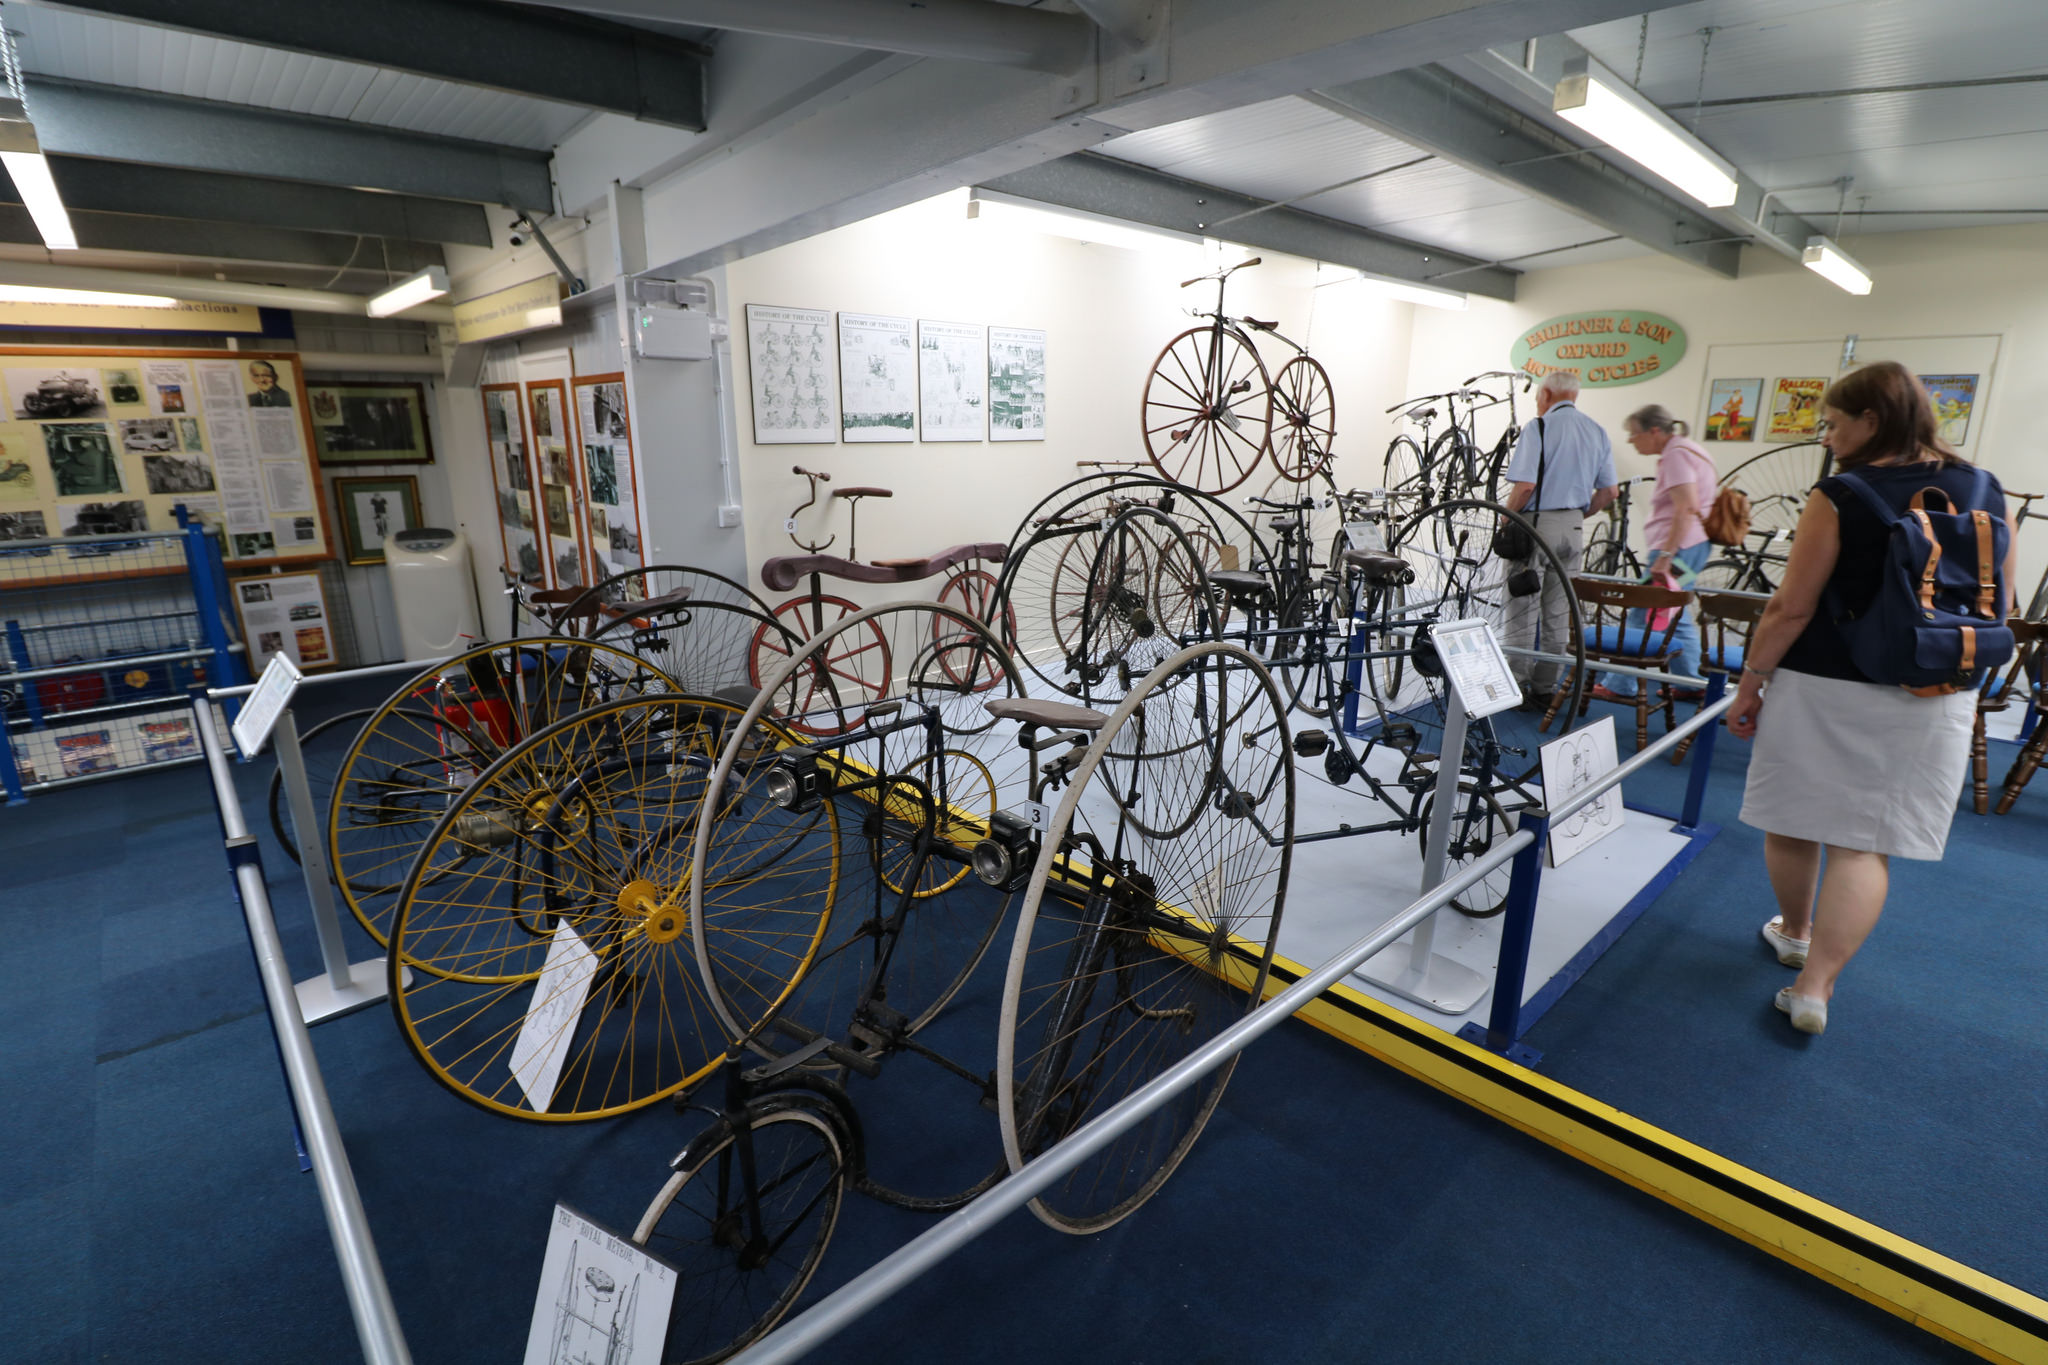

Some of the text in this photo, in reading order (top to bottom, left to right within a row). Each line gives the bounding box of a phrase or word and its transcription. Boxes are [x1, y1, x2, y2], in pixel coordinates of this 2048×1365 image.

[753, 311, 781, 319] HISTORY
[1525, 317, 1675, 350] FAULKNER & SON
[1556, 341, 1631, 359] OXFORD
[1587, 354, 1661, 382] CYCLES
[1777, 378, 1825, 393] RALEIGH
[787, 521, 794, 530] 6
[1031, 808, 1041, 824] 3
[558, 1209, 573, 1228] THE
[658, 1266, 665, 1281] 2
